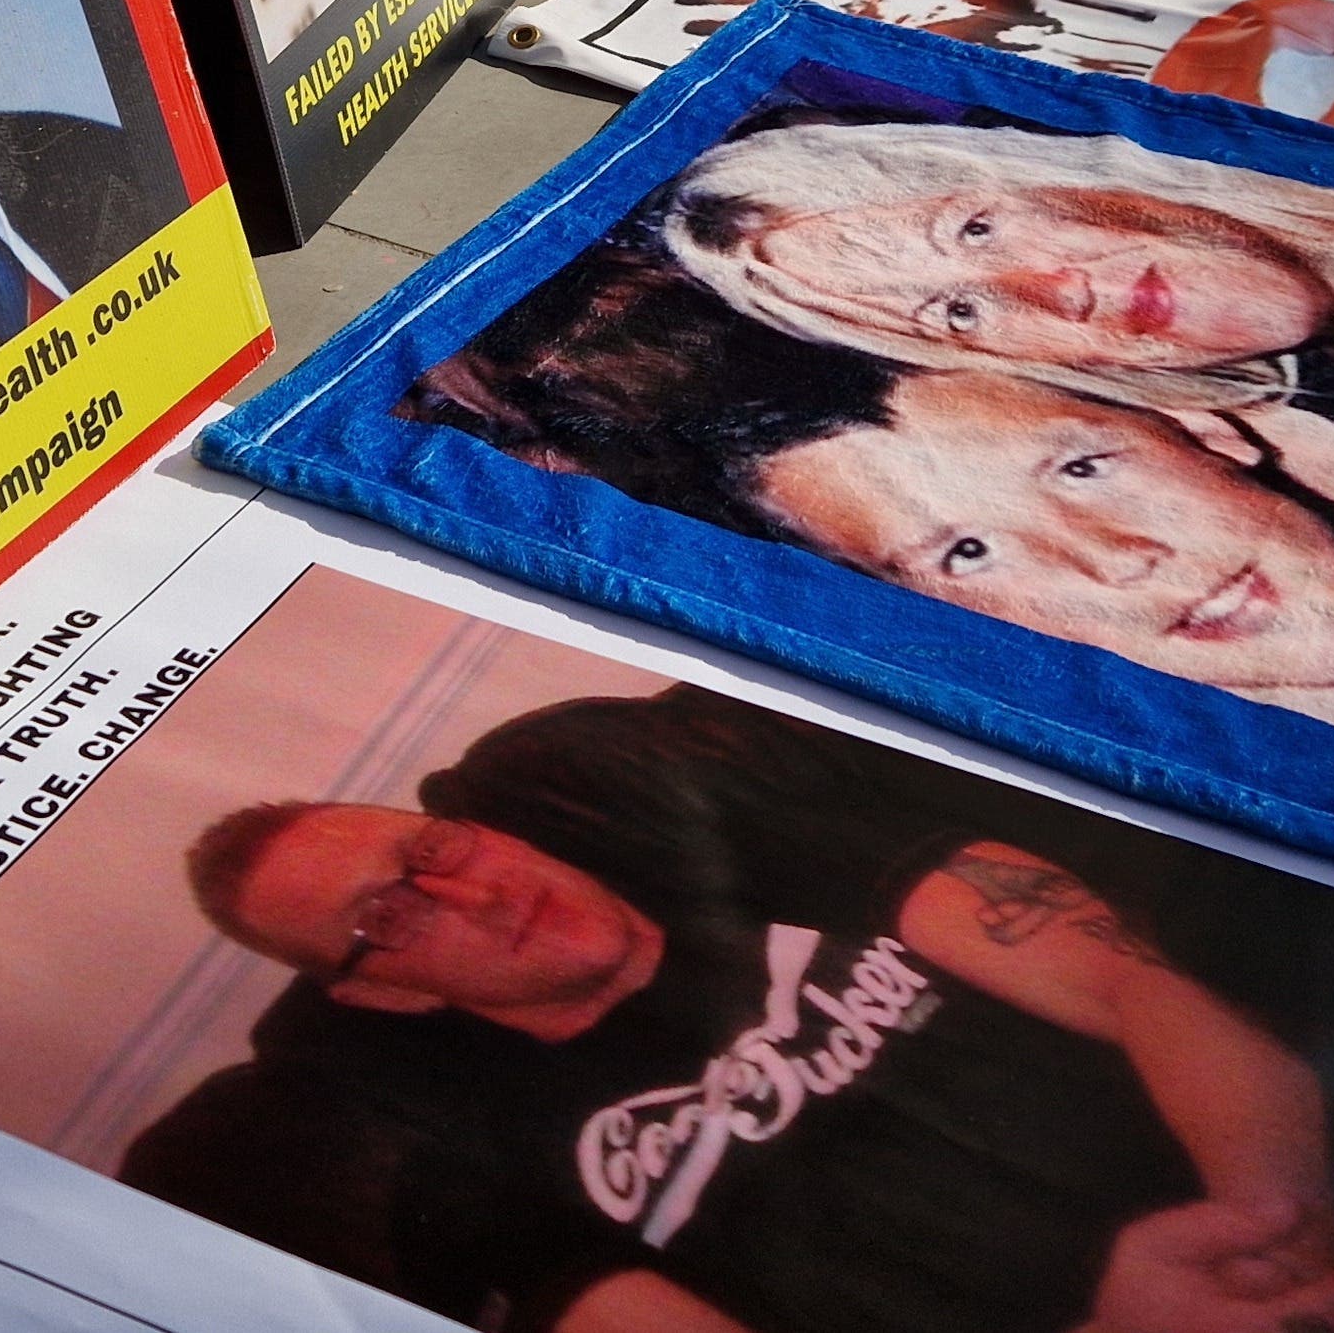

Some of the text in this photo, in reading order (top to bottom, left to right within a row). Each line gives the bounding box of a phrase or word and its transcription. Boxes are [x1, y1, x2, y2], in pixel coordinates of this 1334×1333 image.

[284, 35, 355, 127] FAILED
[353, 1, 382, 56] BY
[336, 45, 410, 147] HEALTH
[84, 249, 182, 350] .co.uk
[78, 643, 219, 762] CHANGE.
